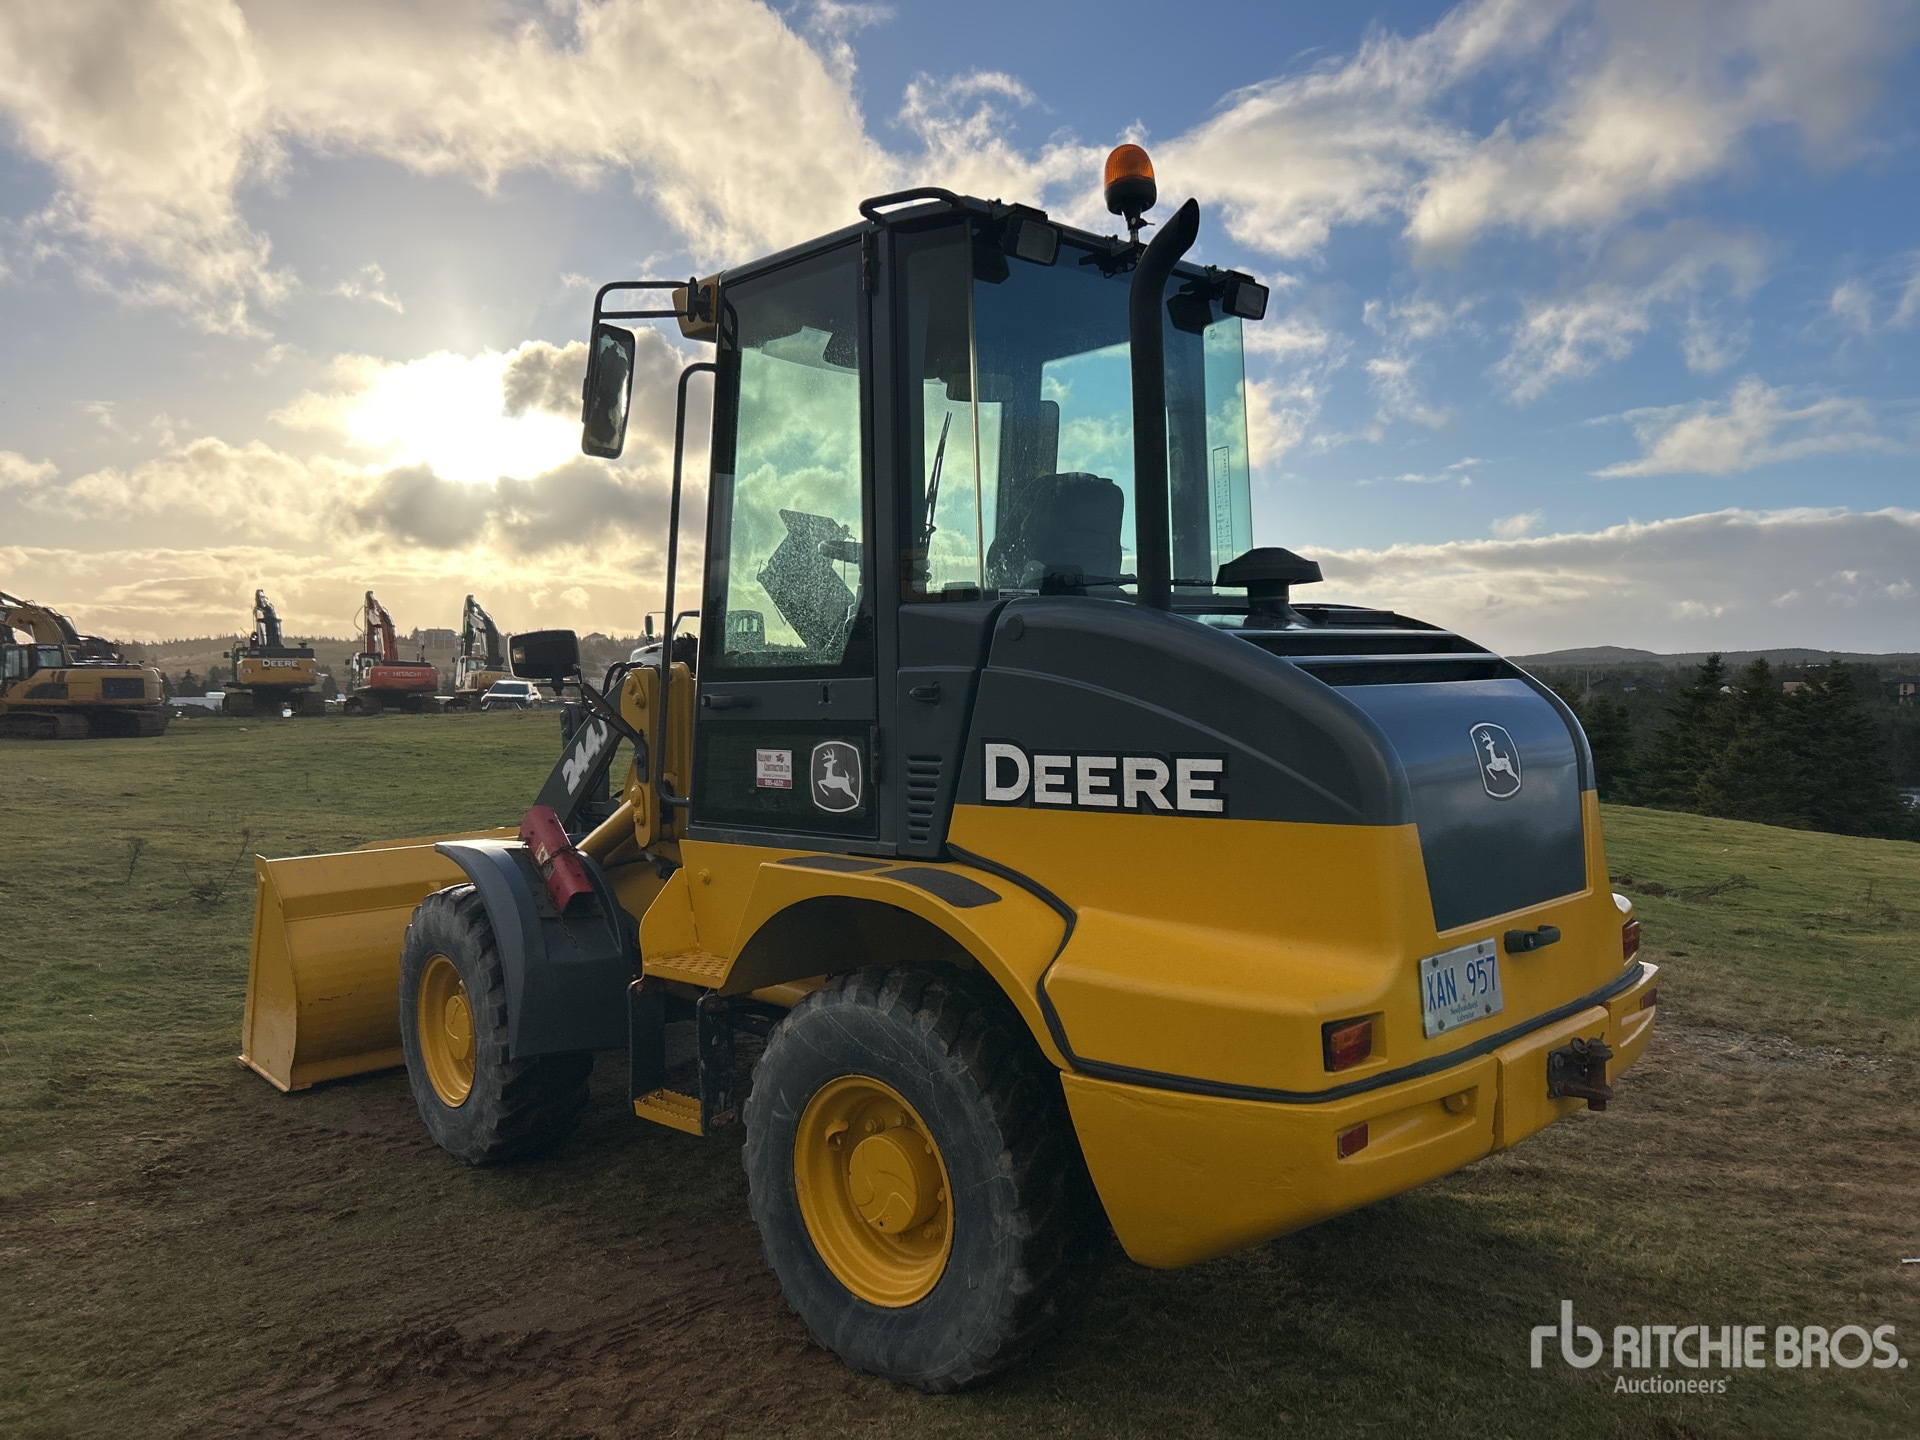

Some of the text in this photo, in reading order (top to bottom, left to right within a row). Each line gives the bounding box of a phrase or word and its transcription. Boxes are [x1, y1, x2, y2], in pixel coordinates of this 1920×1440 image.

[262, 659, 299, 667] DEERE
[985, 743, 1223, 812] DEERE
[1426, 955, 1496, 1012] XAN 957
[1450, 1001, 1479, 1016] Newfoundland
